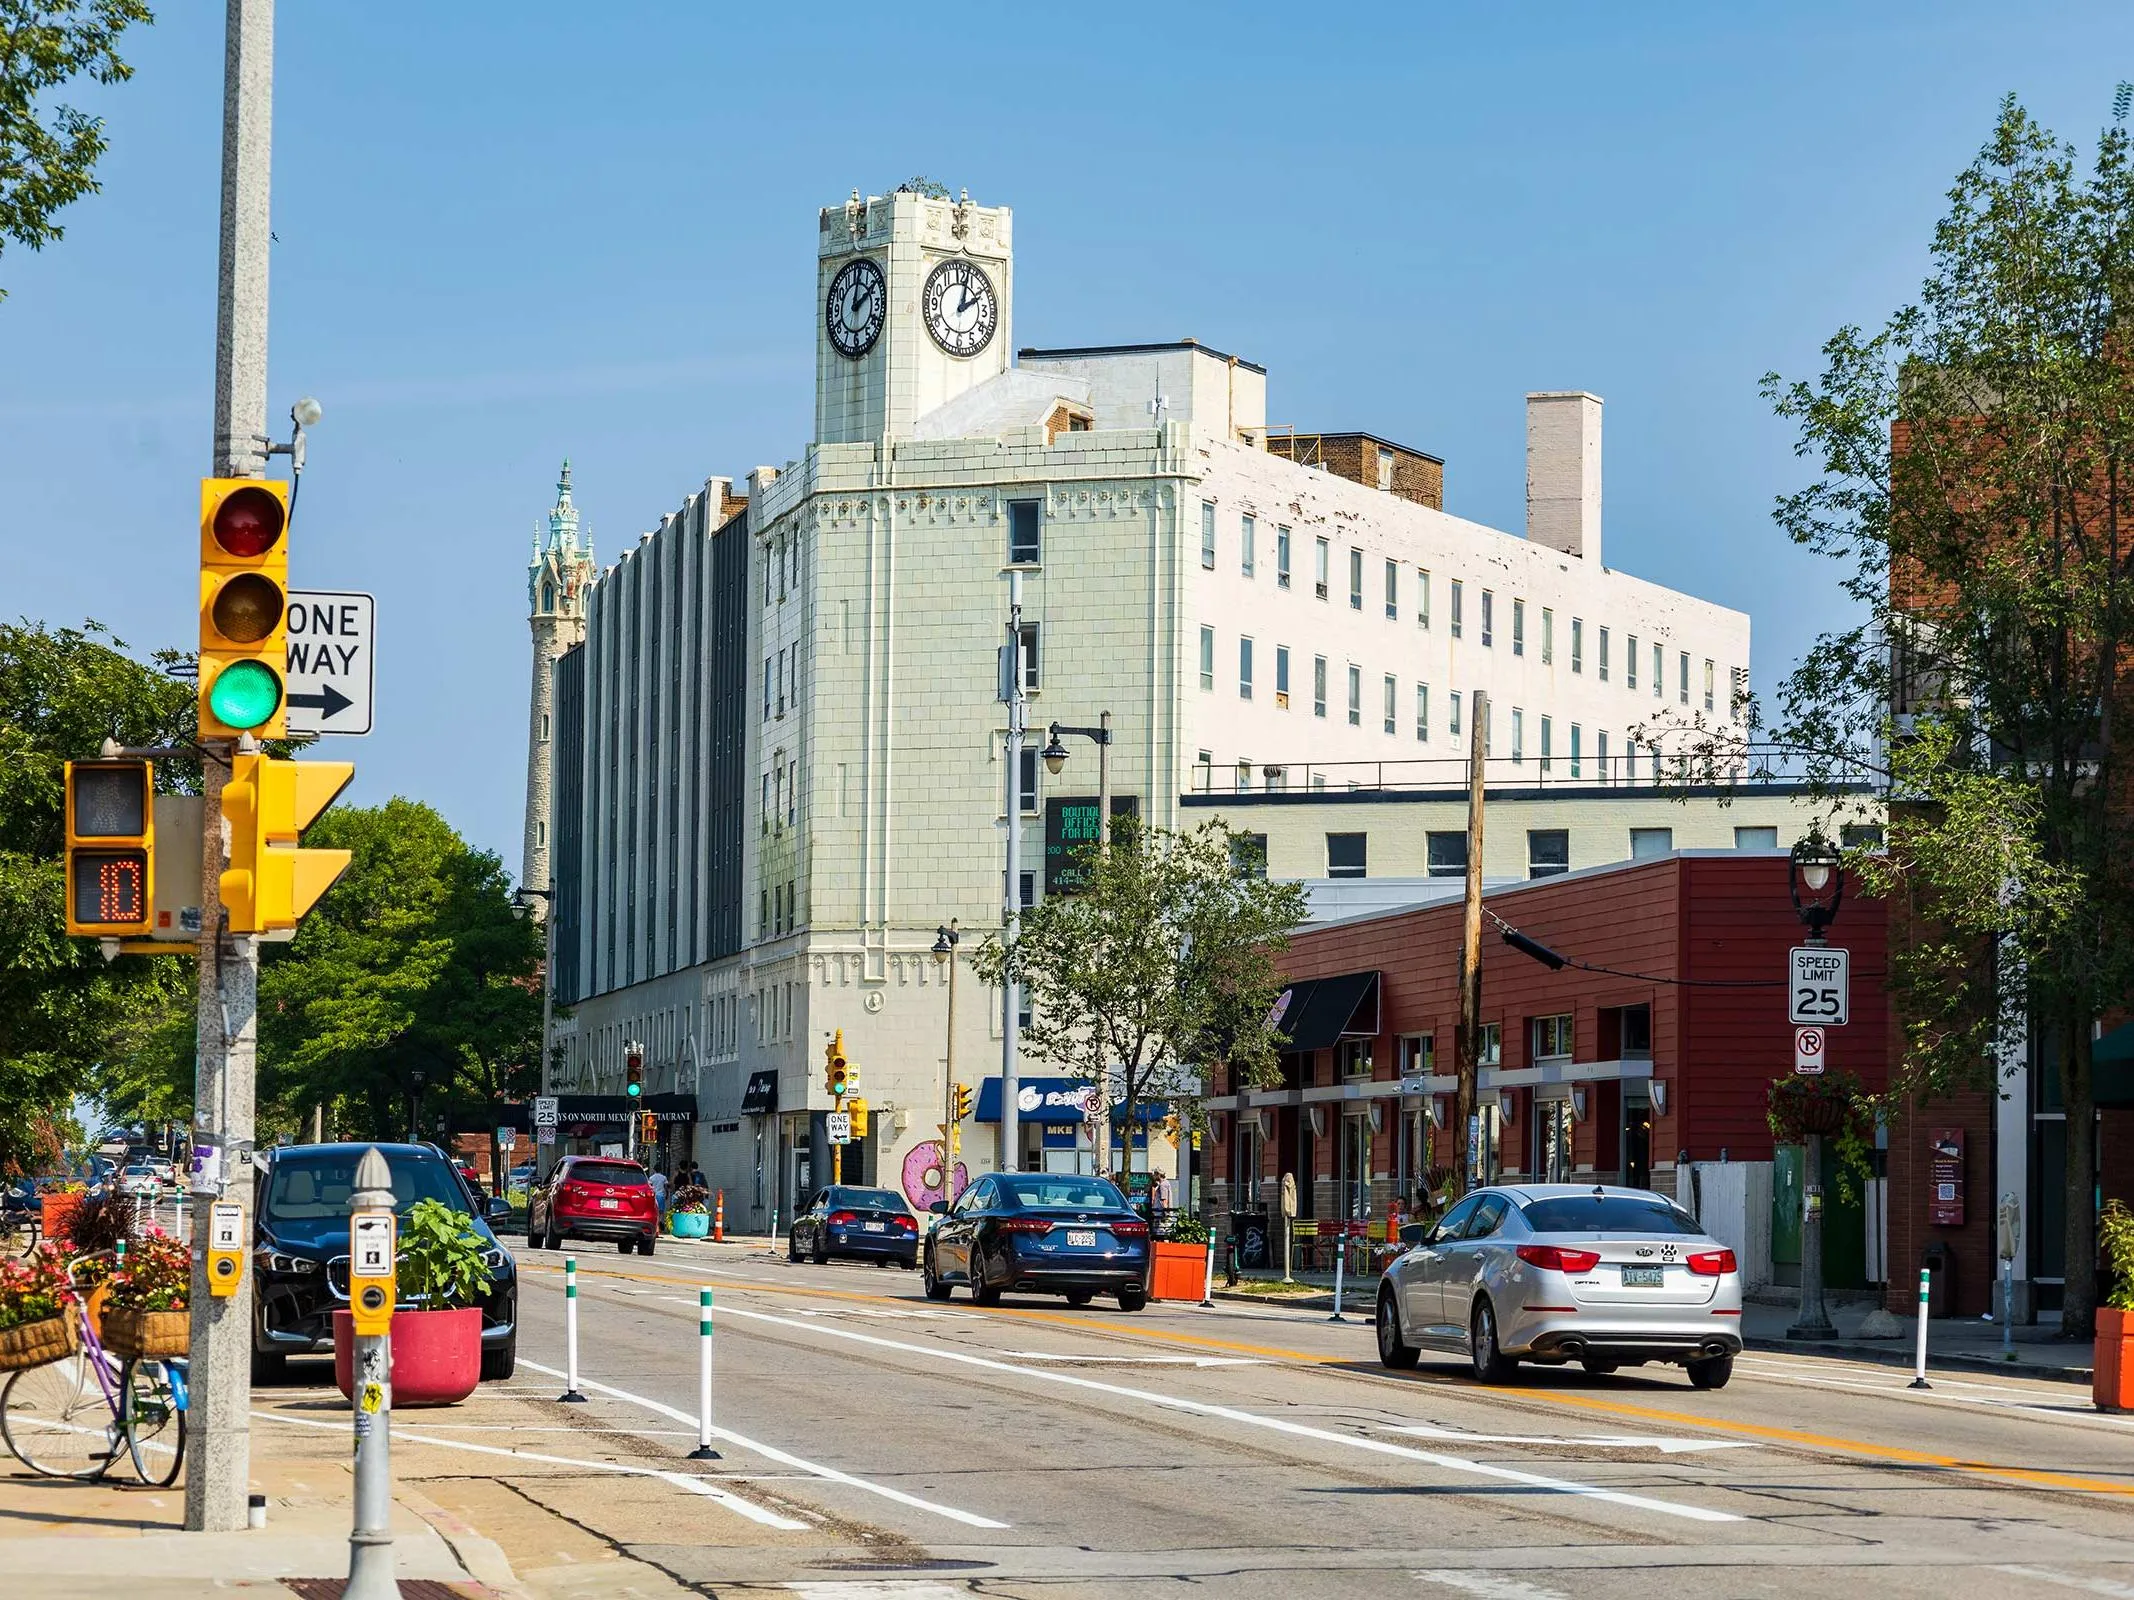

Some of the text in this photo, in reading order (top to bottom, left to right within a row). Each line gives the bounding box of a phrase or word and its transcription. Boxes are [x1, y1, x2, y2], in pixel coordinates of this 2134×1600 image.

[933, 283, 943, 297] 10
[931, 297, 938, 311] 9
[981, 304, 988, 318] 3
[944, 327, 950, 341] 7
[956, 334, 963, 347] 6
[968, 332, 975, 346] 5
[286, 602, 359, 636] ONE
[286, 642, 359, 676] WAY
[1061, 827, 1100, 839] FOR REN
[1061, 868, 1083, 877] CALL
[100, 861, 140, 920] 10
[1797, 956, 1841, 969] SPEED
[1802, 969, 1835, 981] LIMIT
[1796, 987, 1840, 1016] 25
[537, 1112, 555, 1122] 25
[568, 1112, 579, 1121] ON
[580, 1112, 606, 1121] NORTH
[830, 1115, 848, 1123] ONE
[830, 1123, 848, 1131] WAY
[1047, 1125, 1073, 1135] MKE
[1637, 1248, 1652, 1257] KIA
